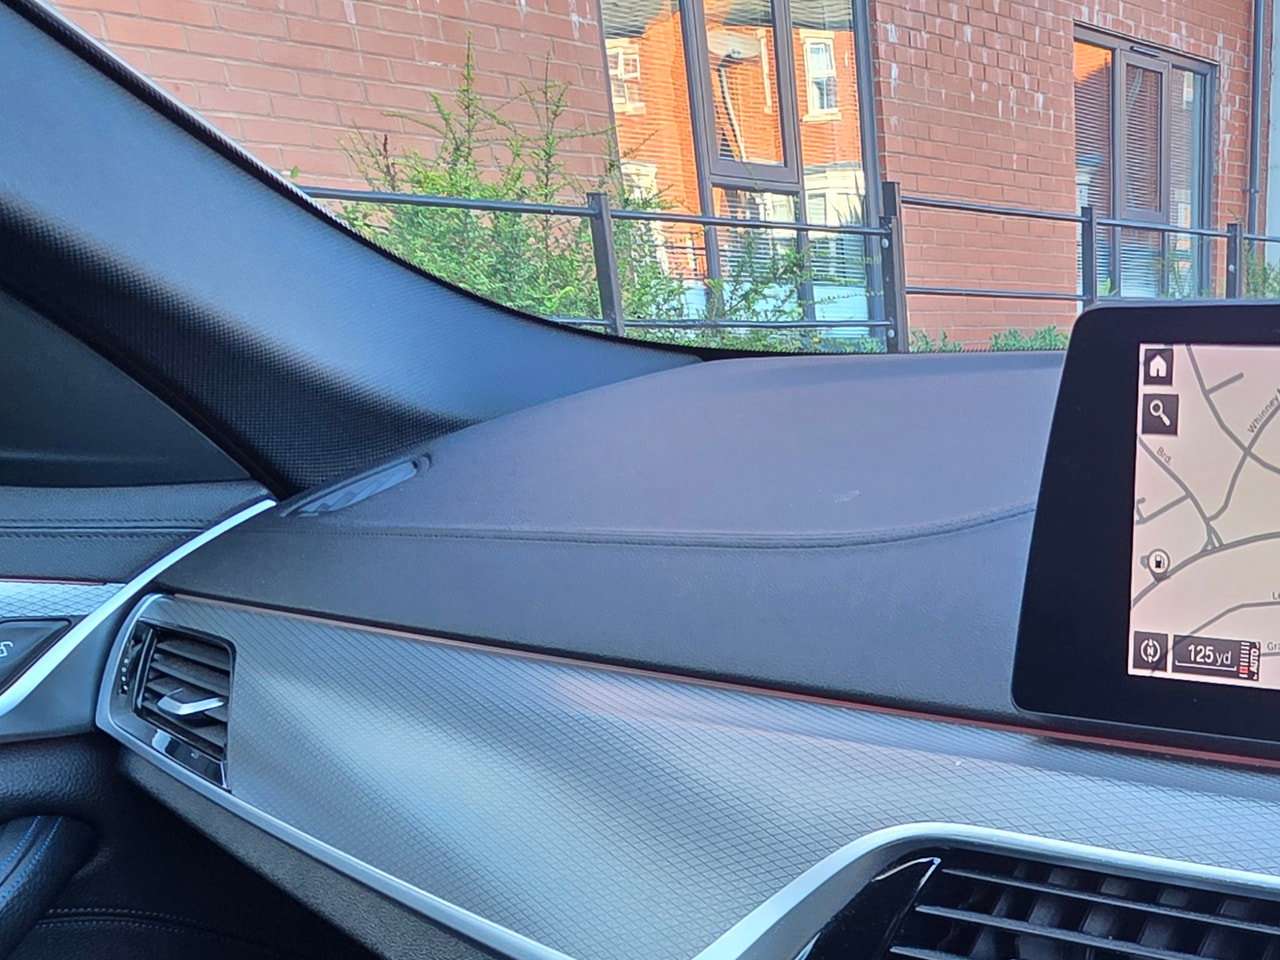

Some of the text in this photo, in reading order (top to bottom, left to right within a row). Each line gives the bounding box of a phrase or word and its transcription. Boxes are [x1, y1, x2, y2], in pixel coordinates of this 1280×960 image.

[1248, 394, 1280, 433] Whinney
[1187, 644, 1232, 665] 125 yd
[1249, 647, 1260, 672] AUTO
